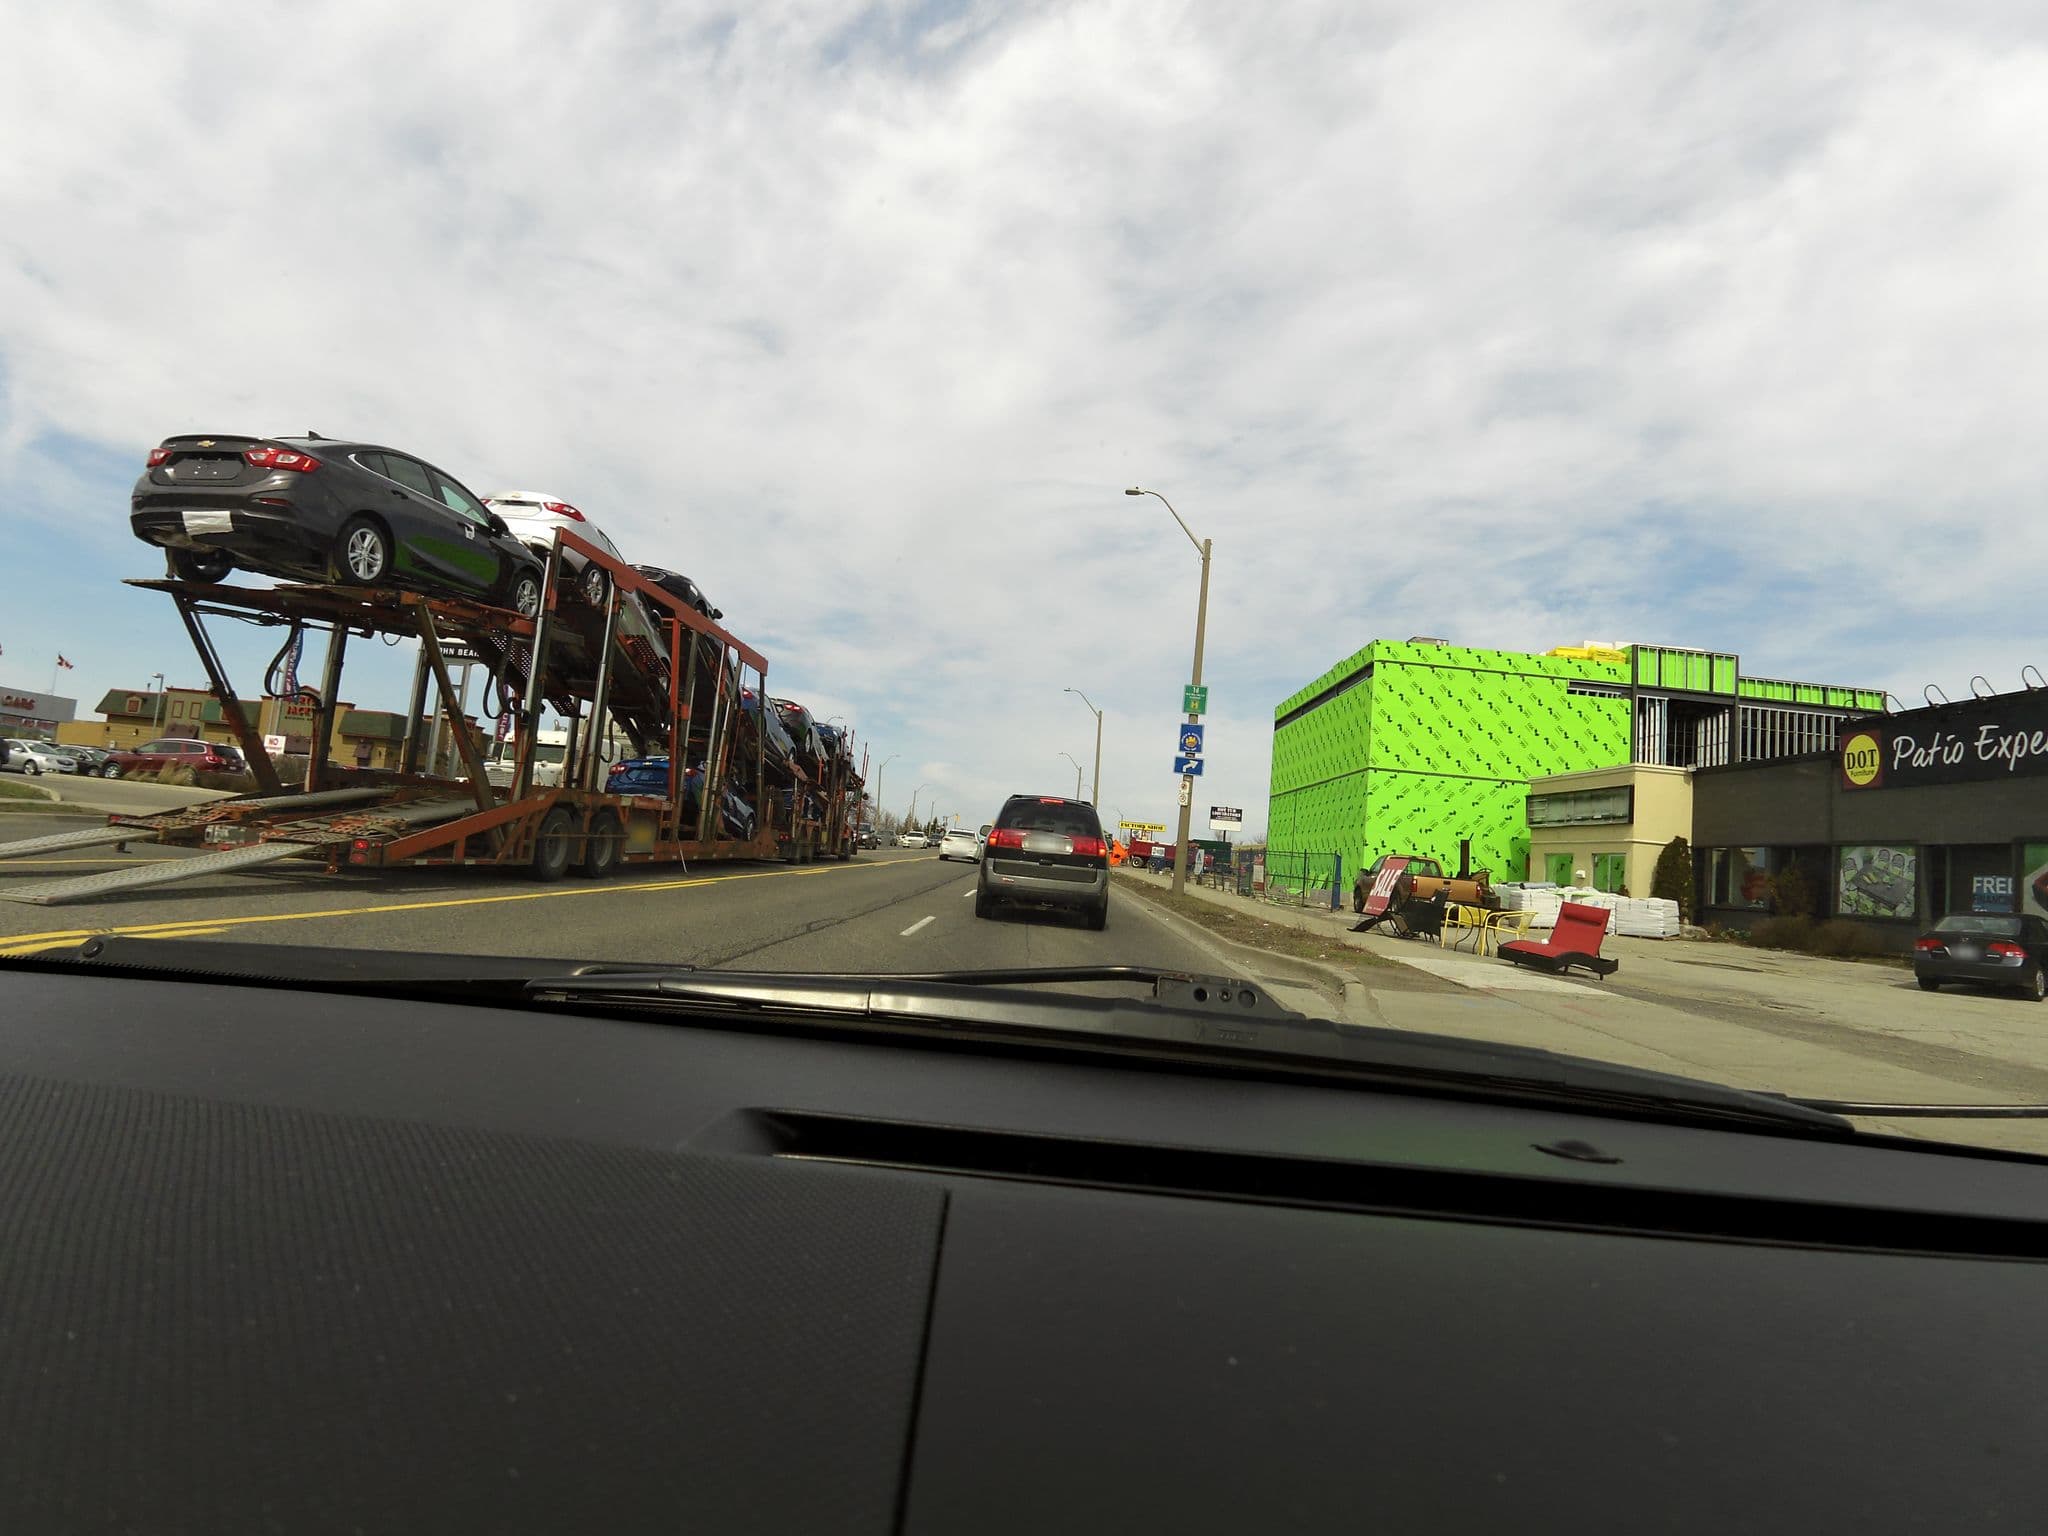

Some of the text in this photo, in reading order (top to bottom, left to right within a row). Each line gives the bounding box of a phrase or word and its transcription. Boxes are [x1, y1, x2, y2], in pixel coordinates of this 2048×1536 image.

[439, 647, 455, 656] OHN
[1893, 725, 2048, 771] Patio Expe
[1370, 868, 1404, 897] SALE
